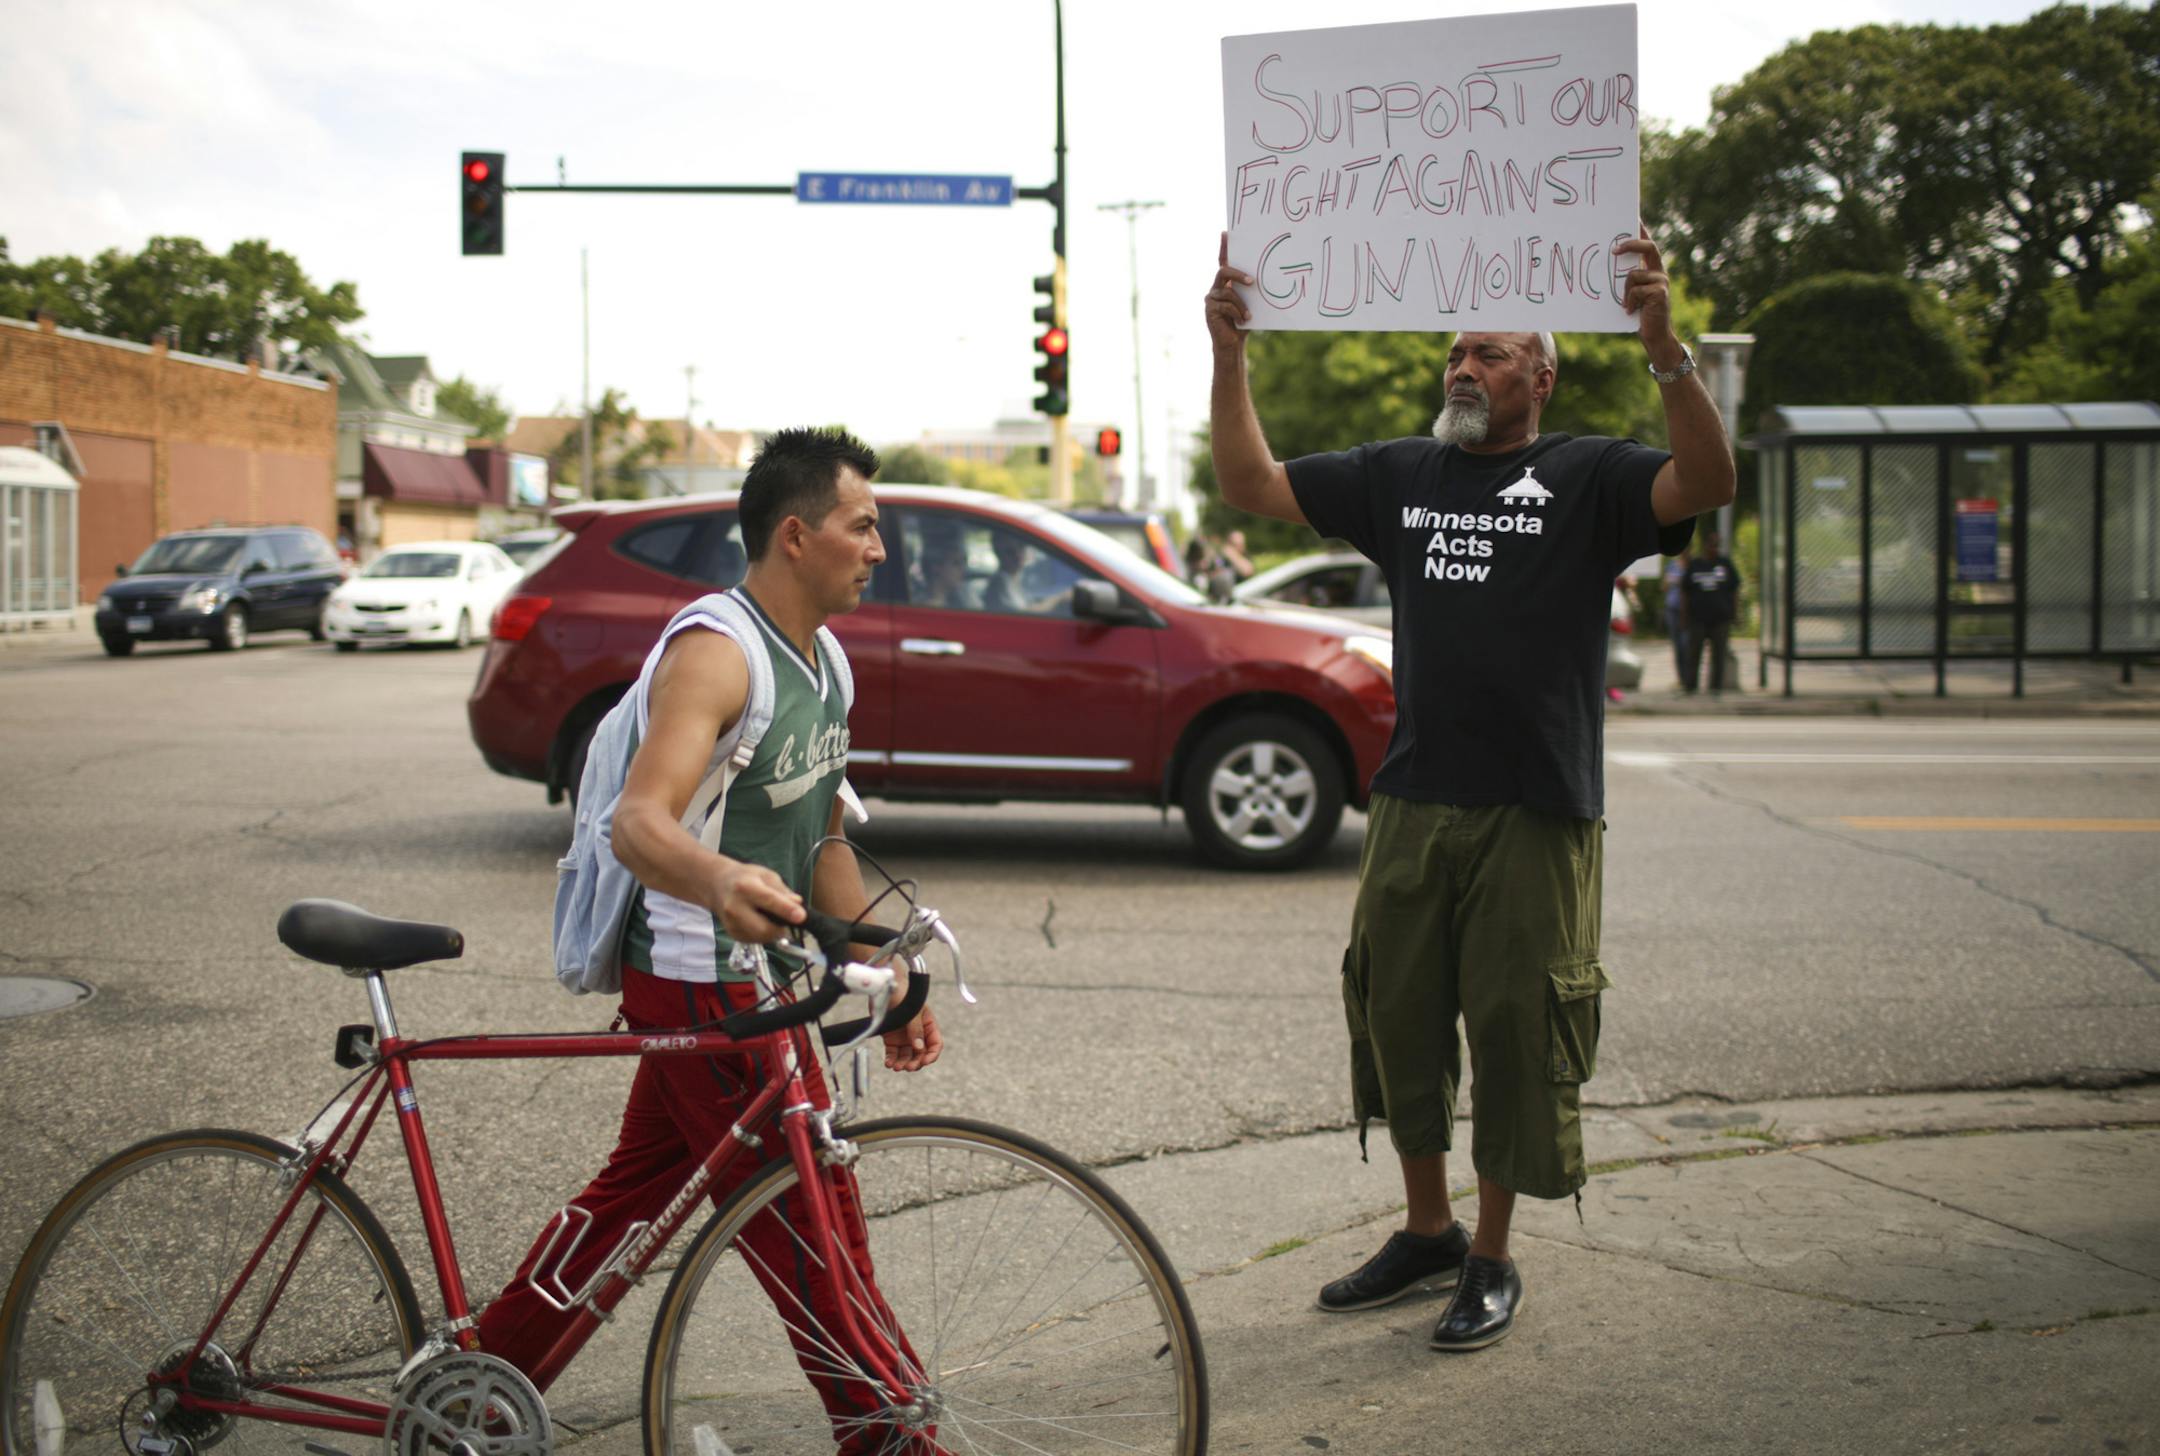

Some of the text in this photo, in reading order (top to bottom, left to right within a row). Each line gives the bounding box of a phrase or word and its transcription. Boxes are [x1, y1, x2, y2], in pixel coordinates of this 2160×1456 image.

[1253, 53, 1639, 154] SUPPORT OUR
[806, 177, 825, 199] E
[838, 178, 950, 200] Franklin
[1231, 147, 1624, 229] FIGHT AGAINST
[1256, 233, 1639, 317] GUN VIOLENCE
[1402, 506, 1544, 535] Minnesota
[1426, 531, 1494, 558] Acts
[1424, 556, 1492, 583] Now
